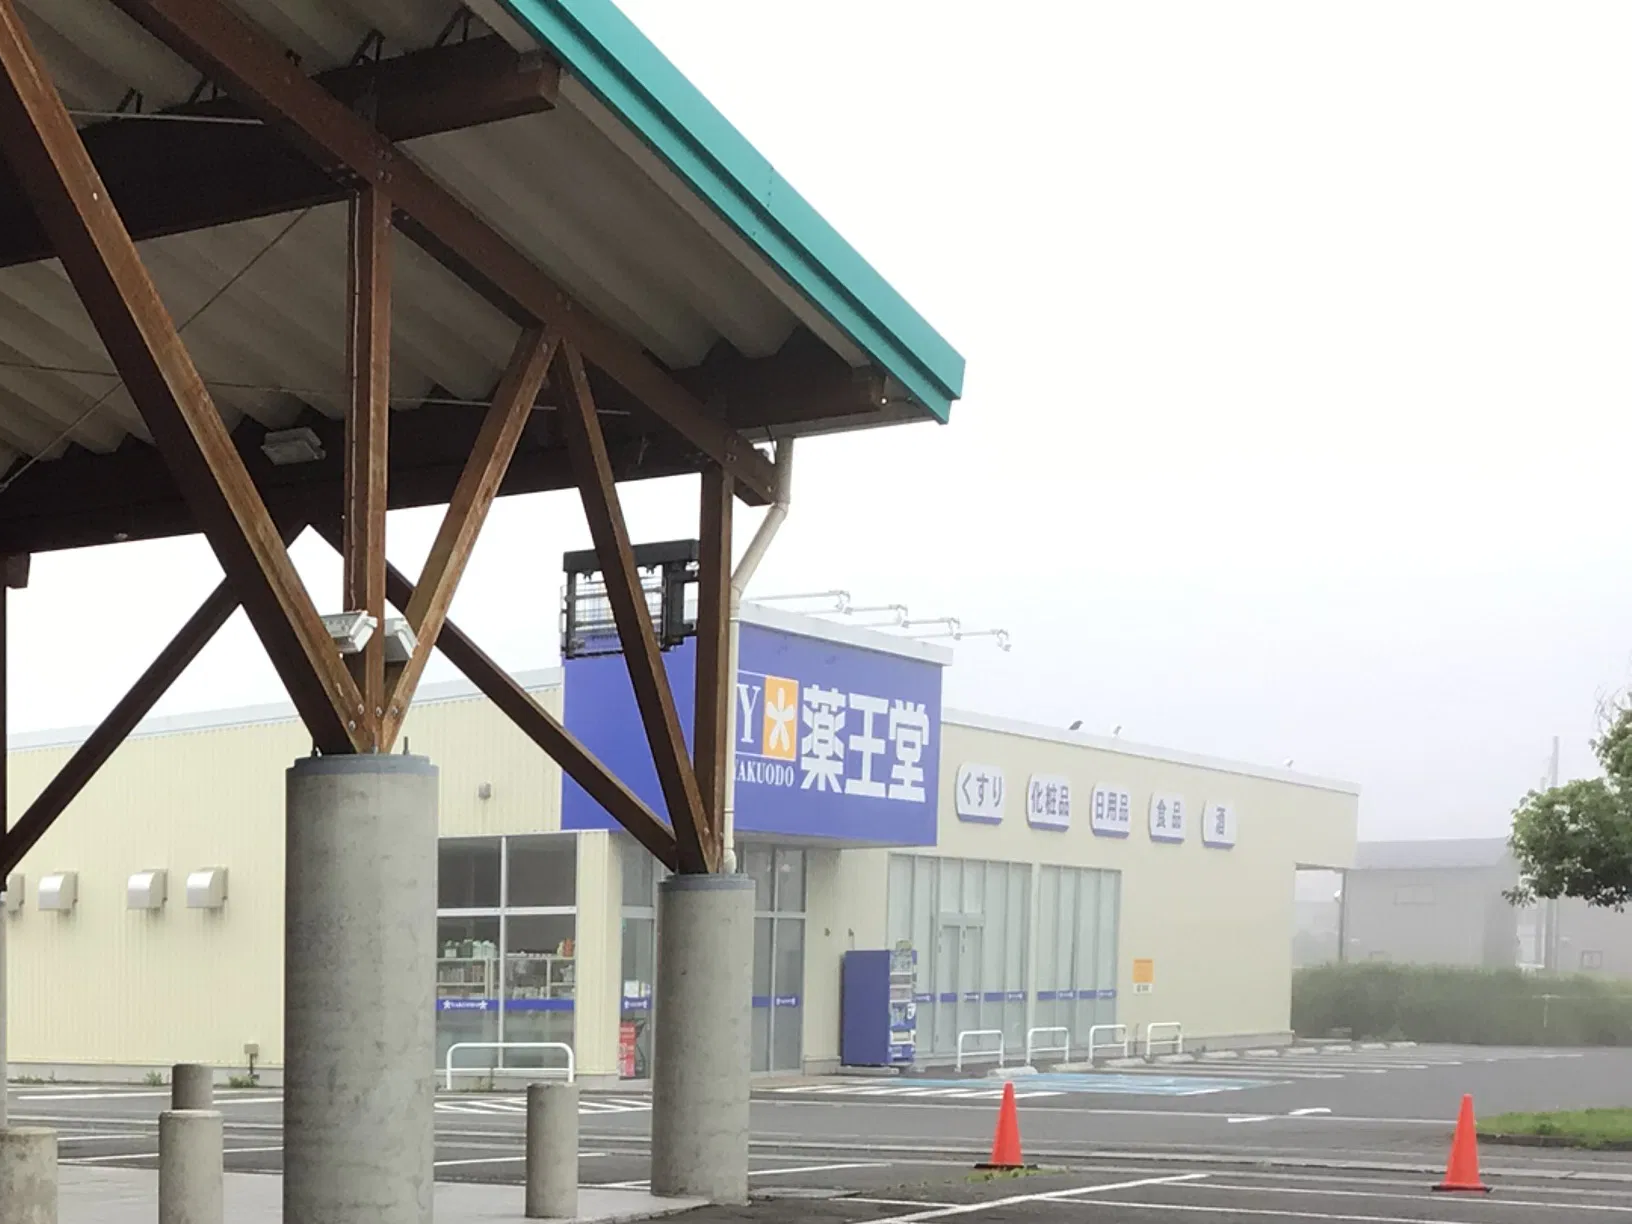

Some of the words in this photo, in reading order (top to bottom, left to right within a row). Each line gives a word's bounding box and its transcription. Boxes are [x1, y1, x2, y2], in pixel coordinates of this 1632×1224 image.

[800, 684, 930, 803] 薬王堂
[962, 771, 1003, 808] くすり
[1031, 781, 1070, 817] 化粧品
[1095, 790, 1130, 823] 日用品
[1155, 799, 1182, 830] 食品
